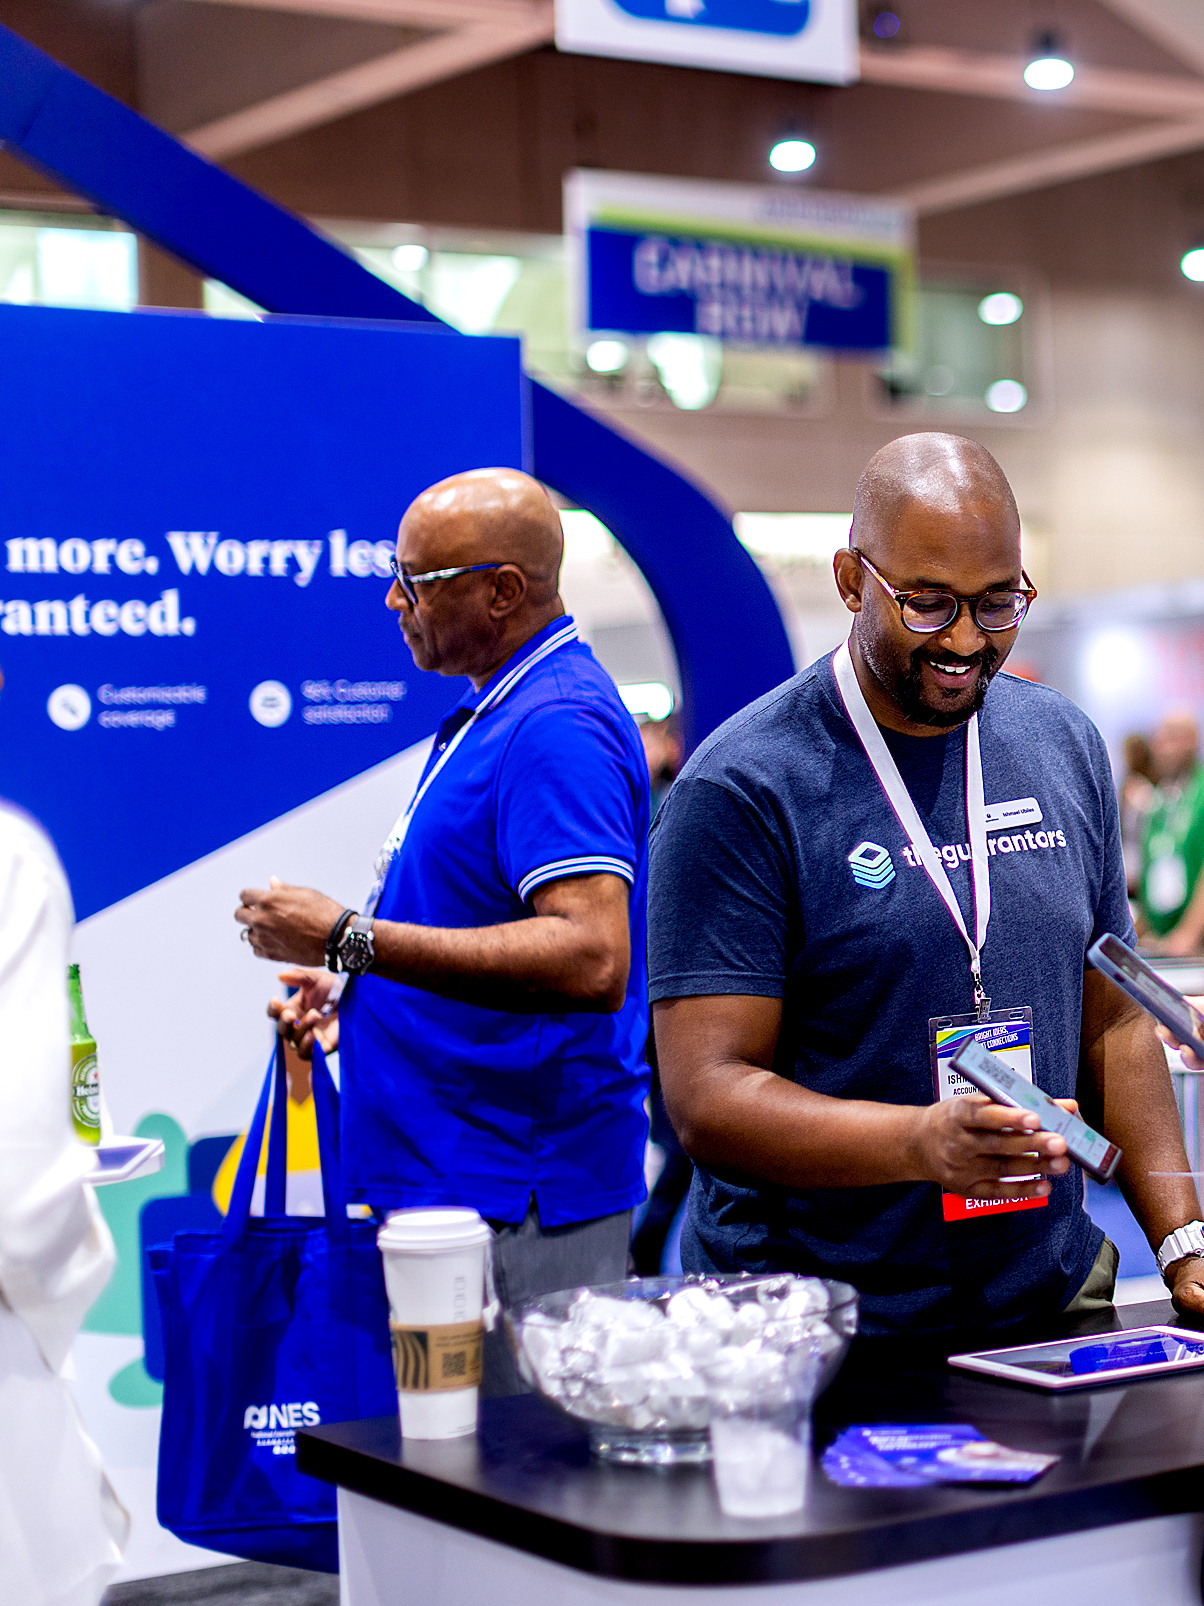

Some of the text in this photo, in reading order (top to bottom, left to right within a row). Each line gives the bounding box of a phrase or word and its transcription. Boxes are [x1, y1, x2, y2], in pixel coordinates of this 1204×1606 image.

[635, 239, 862, 306] CARNIVAL
[696, 300, 808, 342] ROW
[5, 528, 396, 587] more. Worry les
[0, 588, 197, 637] anteed.
[97, 709, 176, 731] coverage
[903, 829, 1067, 869] thegurantors
[974, 1028, 992, 1042] BRIGHT
[986, 1032, 1019, 1049] CONNECTIONS
[269, 1400, 321, 1430] NES
